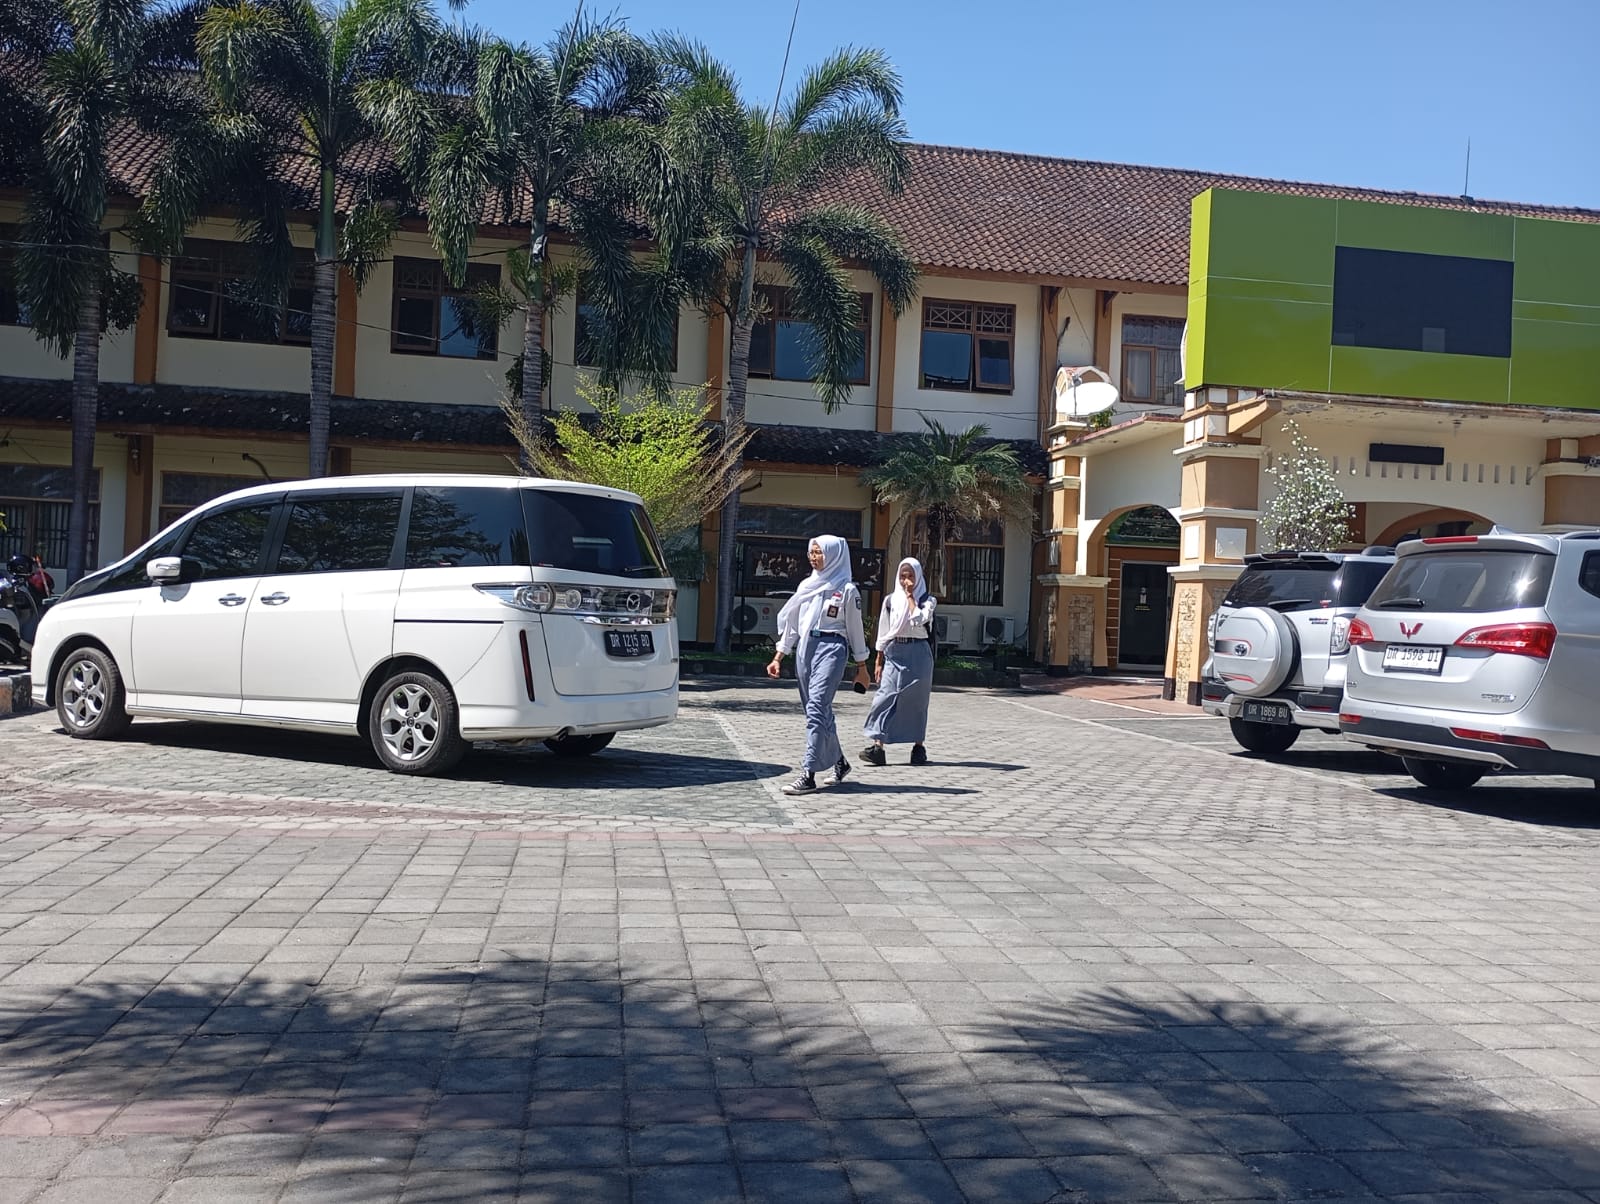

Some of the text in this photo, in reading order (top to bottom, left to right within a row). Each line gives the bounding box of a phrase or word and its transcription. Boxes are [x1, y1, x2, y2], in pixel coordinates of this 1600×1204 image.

[609, 633, 621, 648] DR
[622, 634, 639, 647] 1215
[1386, 647, 1440, 662] DR 1598 DI
[1248, 704, 1258, 715] DR
[1278, 707, 1288, 719] BU
